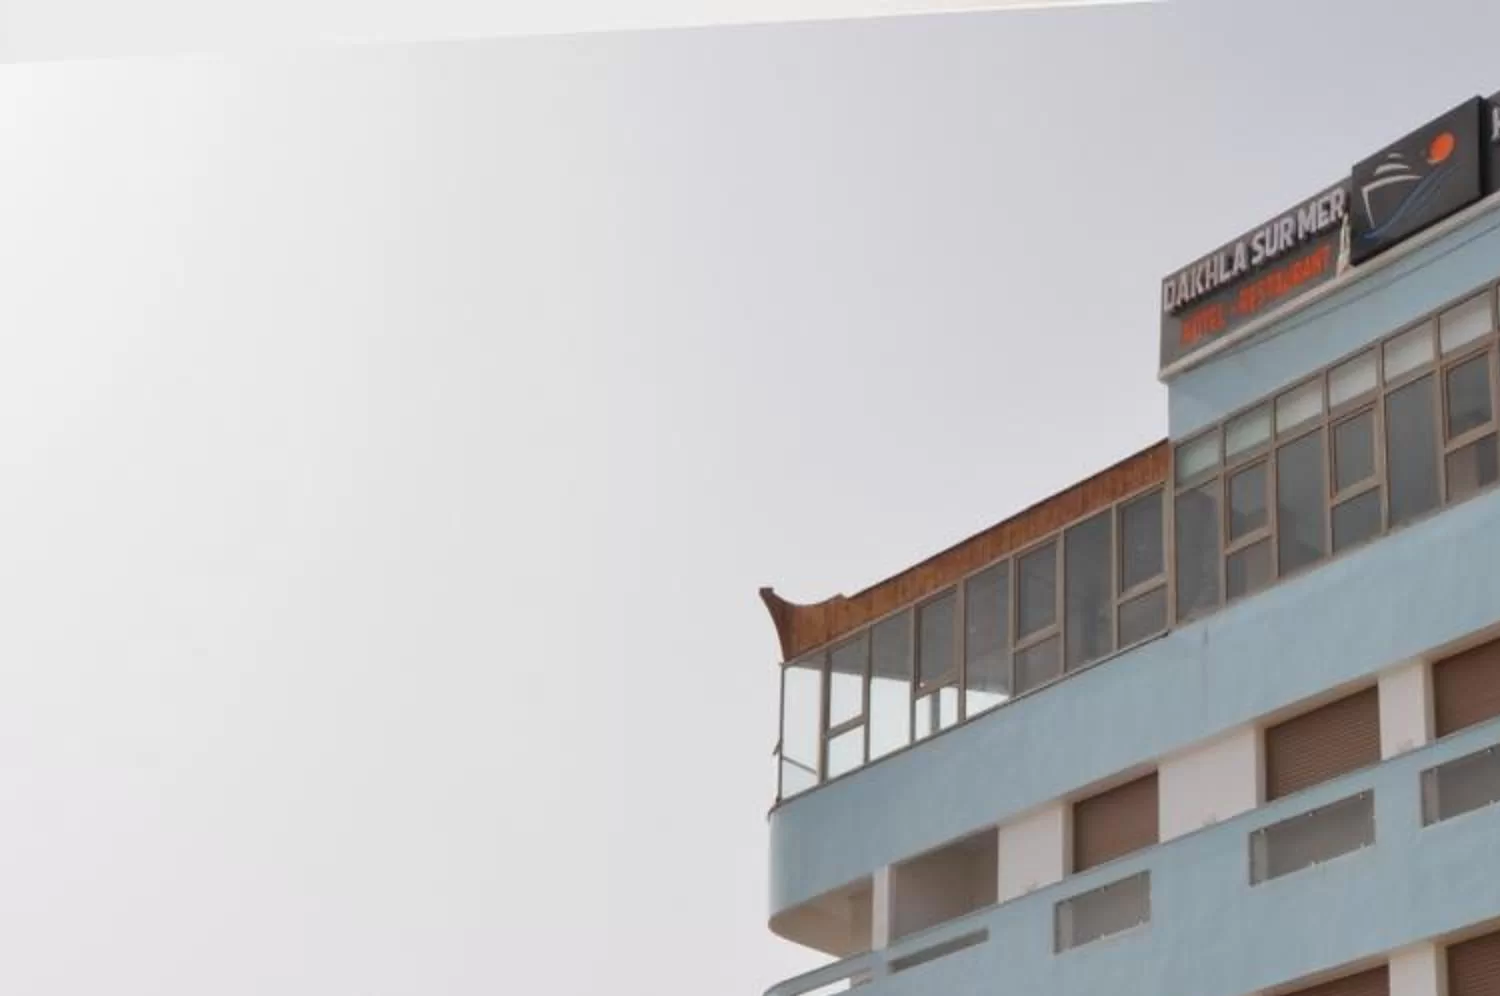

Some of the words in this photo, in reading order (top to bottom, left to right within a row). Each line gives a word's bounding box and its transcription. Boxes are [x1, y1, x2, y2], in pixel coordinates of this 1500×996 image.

[1163, 242, 1248, 313] DAKHLA
[1251, 216, 1296, 265] SUR
[1297, 186, 1346, 240] MER
